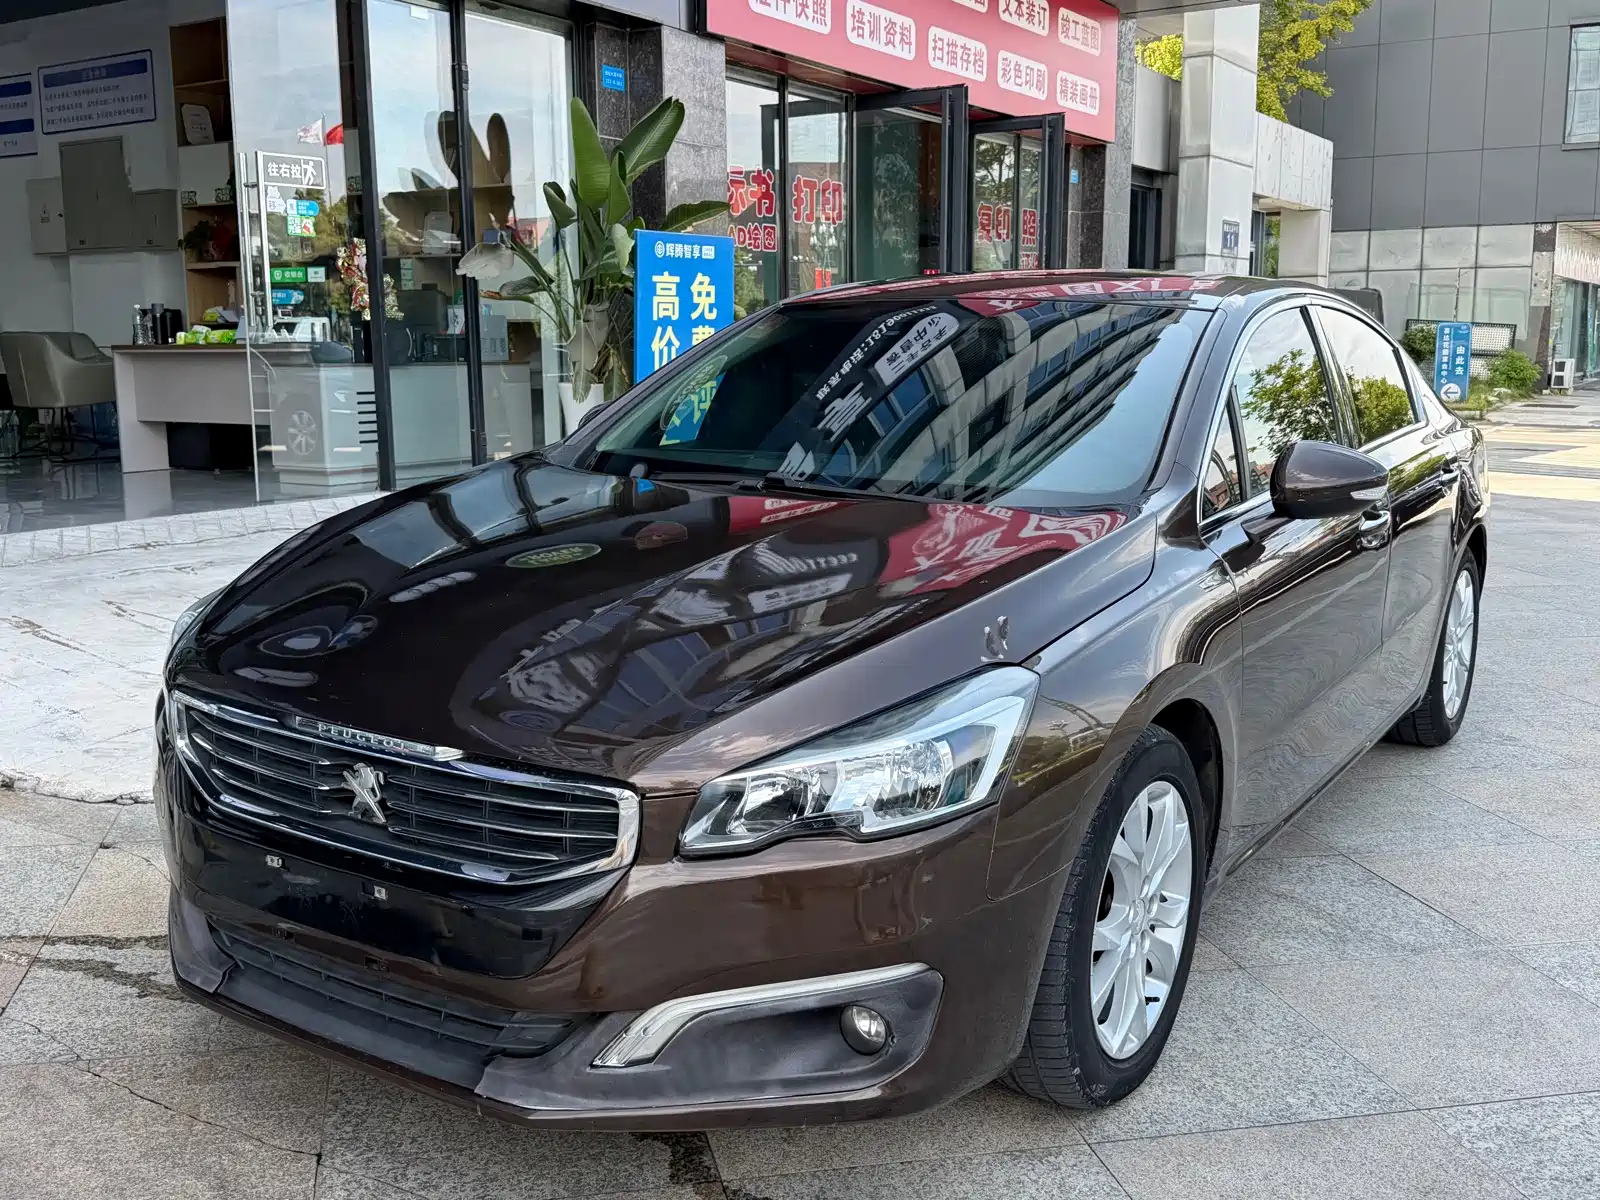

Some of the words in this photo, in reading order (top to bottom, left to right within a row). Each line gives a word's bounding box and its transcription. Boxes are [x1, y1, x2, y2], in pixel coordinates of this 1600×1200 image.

[850, 5, 913, 54] 培训资料
[1060, 14, 1099, 50] 竣工蓝图
[932, 34, 985, 77] 扫描存档
[1001, 56, 1046, 95] 彩色印刷
[1059, 76, 1098, 110] 精装画册
[267, 161, 302, 178] 往右拉
[792, 175, 844, 226] 打印
[977, 201, 1012, 244] 复印
[1454, 345, 1466, 375] 由此去
